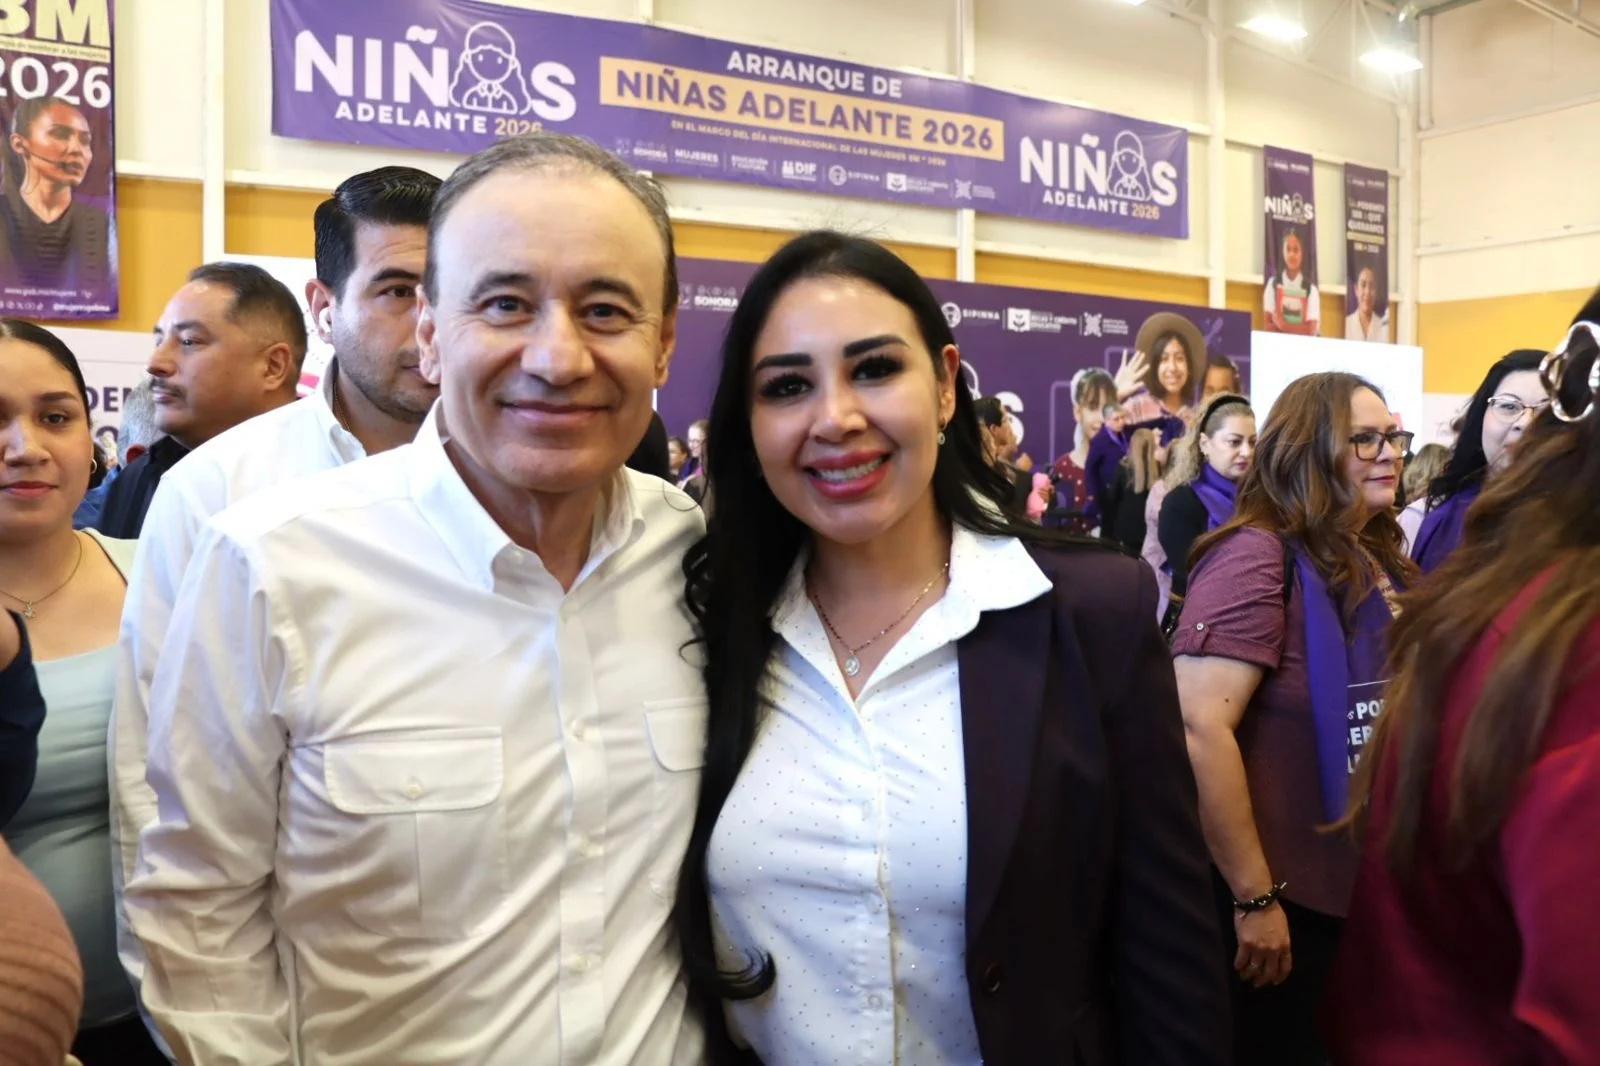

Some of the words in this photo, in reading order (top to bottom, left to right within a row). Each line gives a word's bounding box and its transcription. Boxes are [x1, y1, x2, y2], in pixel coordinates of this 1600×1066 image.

[727, 50, 865, 93] ARRANQUE
[872, 75, 903, 98] DE
[335, 101, 487, 133] ADELANTE
[616, 68, 727, 112] NIÑAS
[738, 91, 912, 140] ADELANTE
[923, 119, 993, 150] 2026
[675, 147, 719, 163] MUJERES
[795, 160, 817, 175] DIF
[1043, 189, 1128, 215] ADELANTE
[1131, 202, 1160, 220] 2026
[694, 295, 739, 307] SONORA
[962, 308, 1000, 321] SIPINNA
